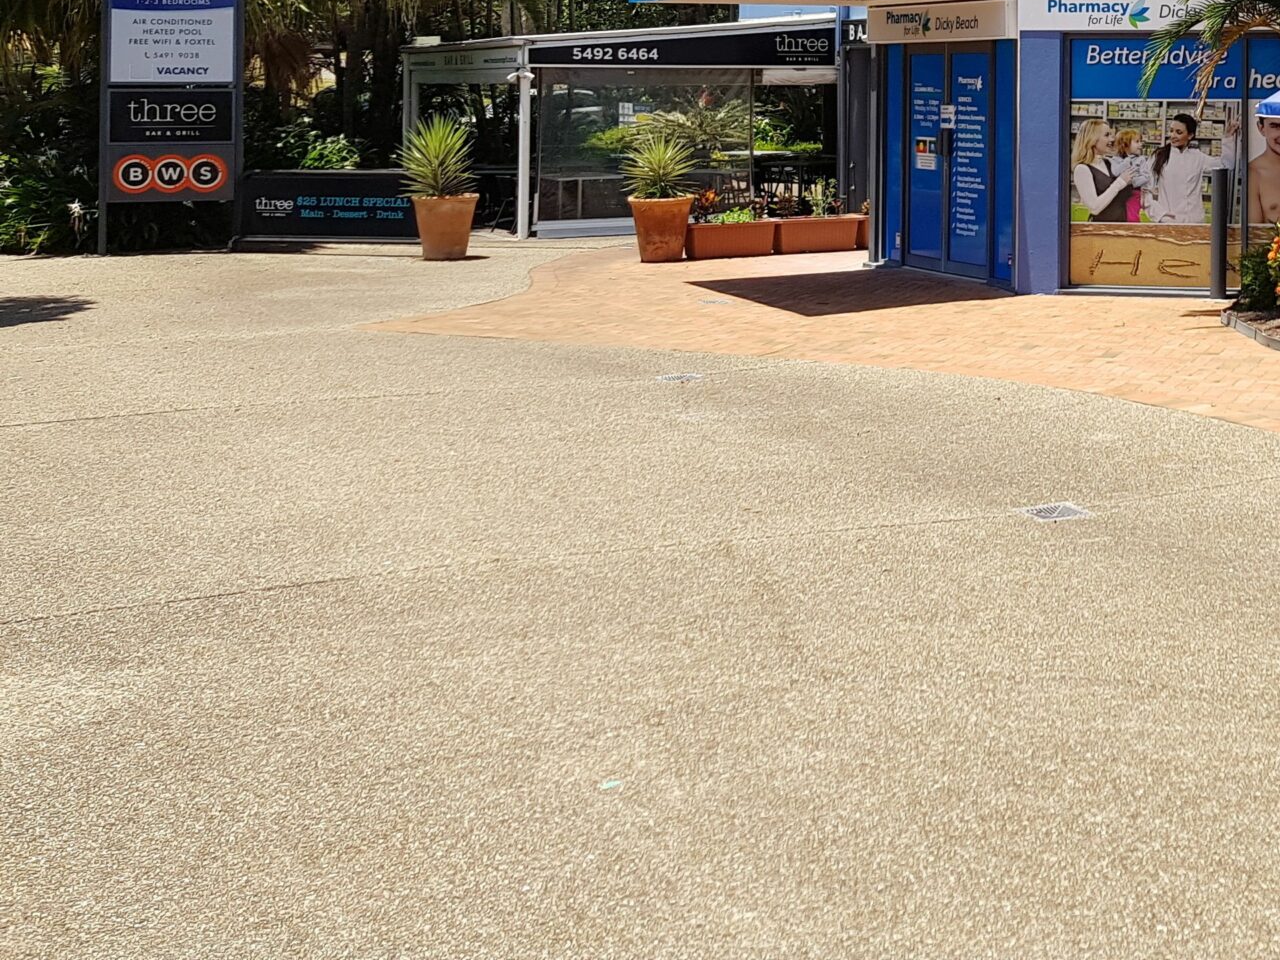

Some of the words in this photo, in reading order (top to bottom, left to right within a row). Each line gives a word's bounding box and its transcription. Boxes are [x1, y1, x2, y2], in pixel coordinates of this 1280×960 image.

[1047, 0, 1130, 16] Pharmacy
[150, 18, 213, 26] CONDITIONED
[886, 11, 922, 26] Pharmacy
[935, 17, 954, 33] Dicky
[955, 15, 979, 30] Beach
[1088, 14, 1103, 27] for
[1105, 14, 1124, 27] Life
[142, 28, 175, 36] HEATED
[179, 28, 202, 36] POOL
[185, 38, 216, 46] FOXTEL
[774, 34, 829, 51] three
[572, 47, 613, 60] 5492
[618, 47, 659, 60] 6464
[1086, 44, 1148, 65] Better
[157, 67, 209, 75] VACANCY
[1223, 75, 1237, 88] a
[127, 98, 216, 122] three
[255, 197, 294, 210] three
[320, 196, 359, 207] LUNCH
[362, 197, 410, 208] SPECIAL
[301, 209, 324, 218] Main
[332, 210, 367, 218] Dessert
[376, 210, 404, 219] Drink
